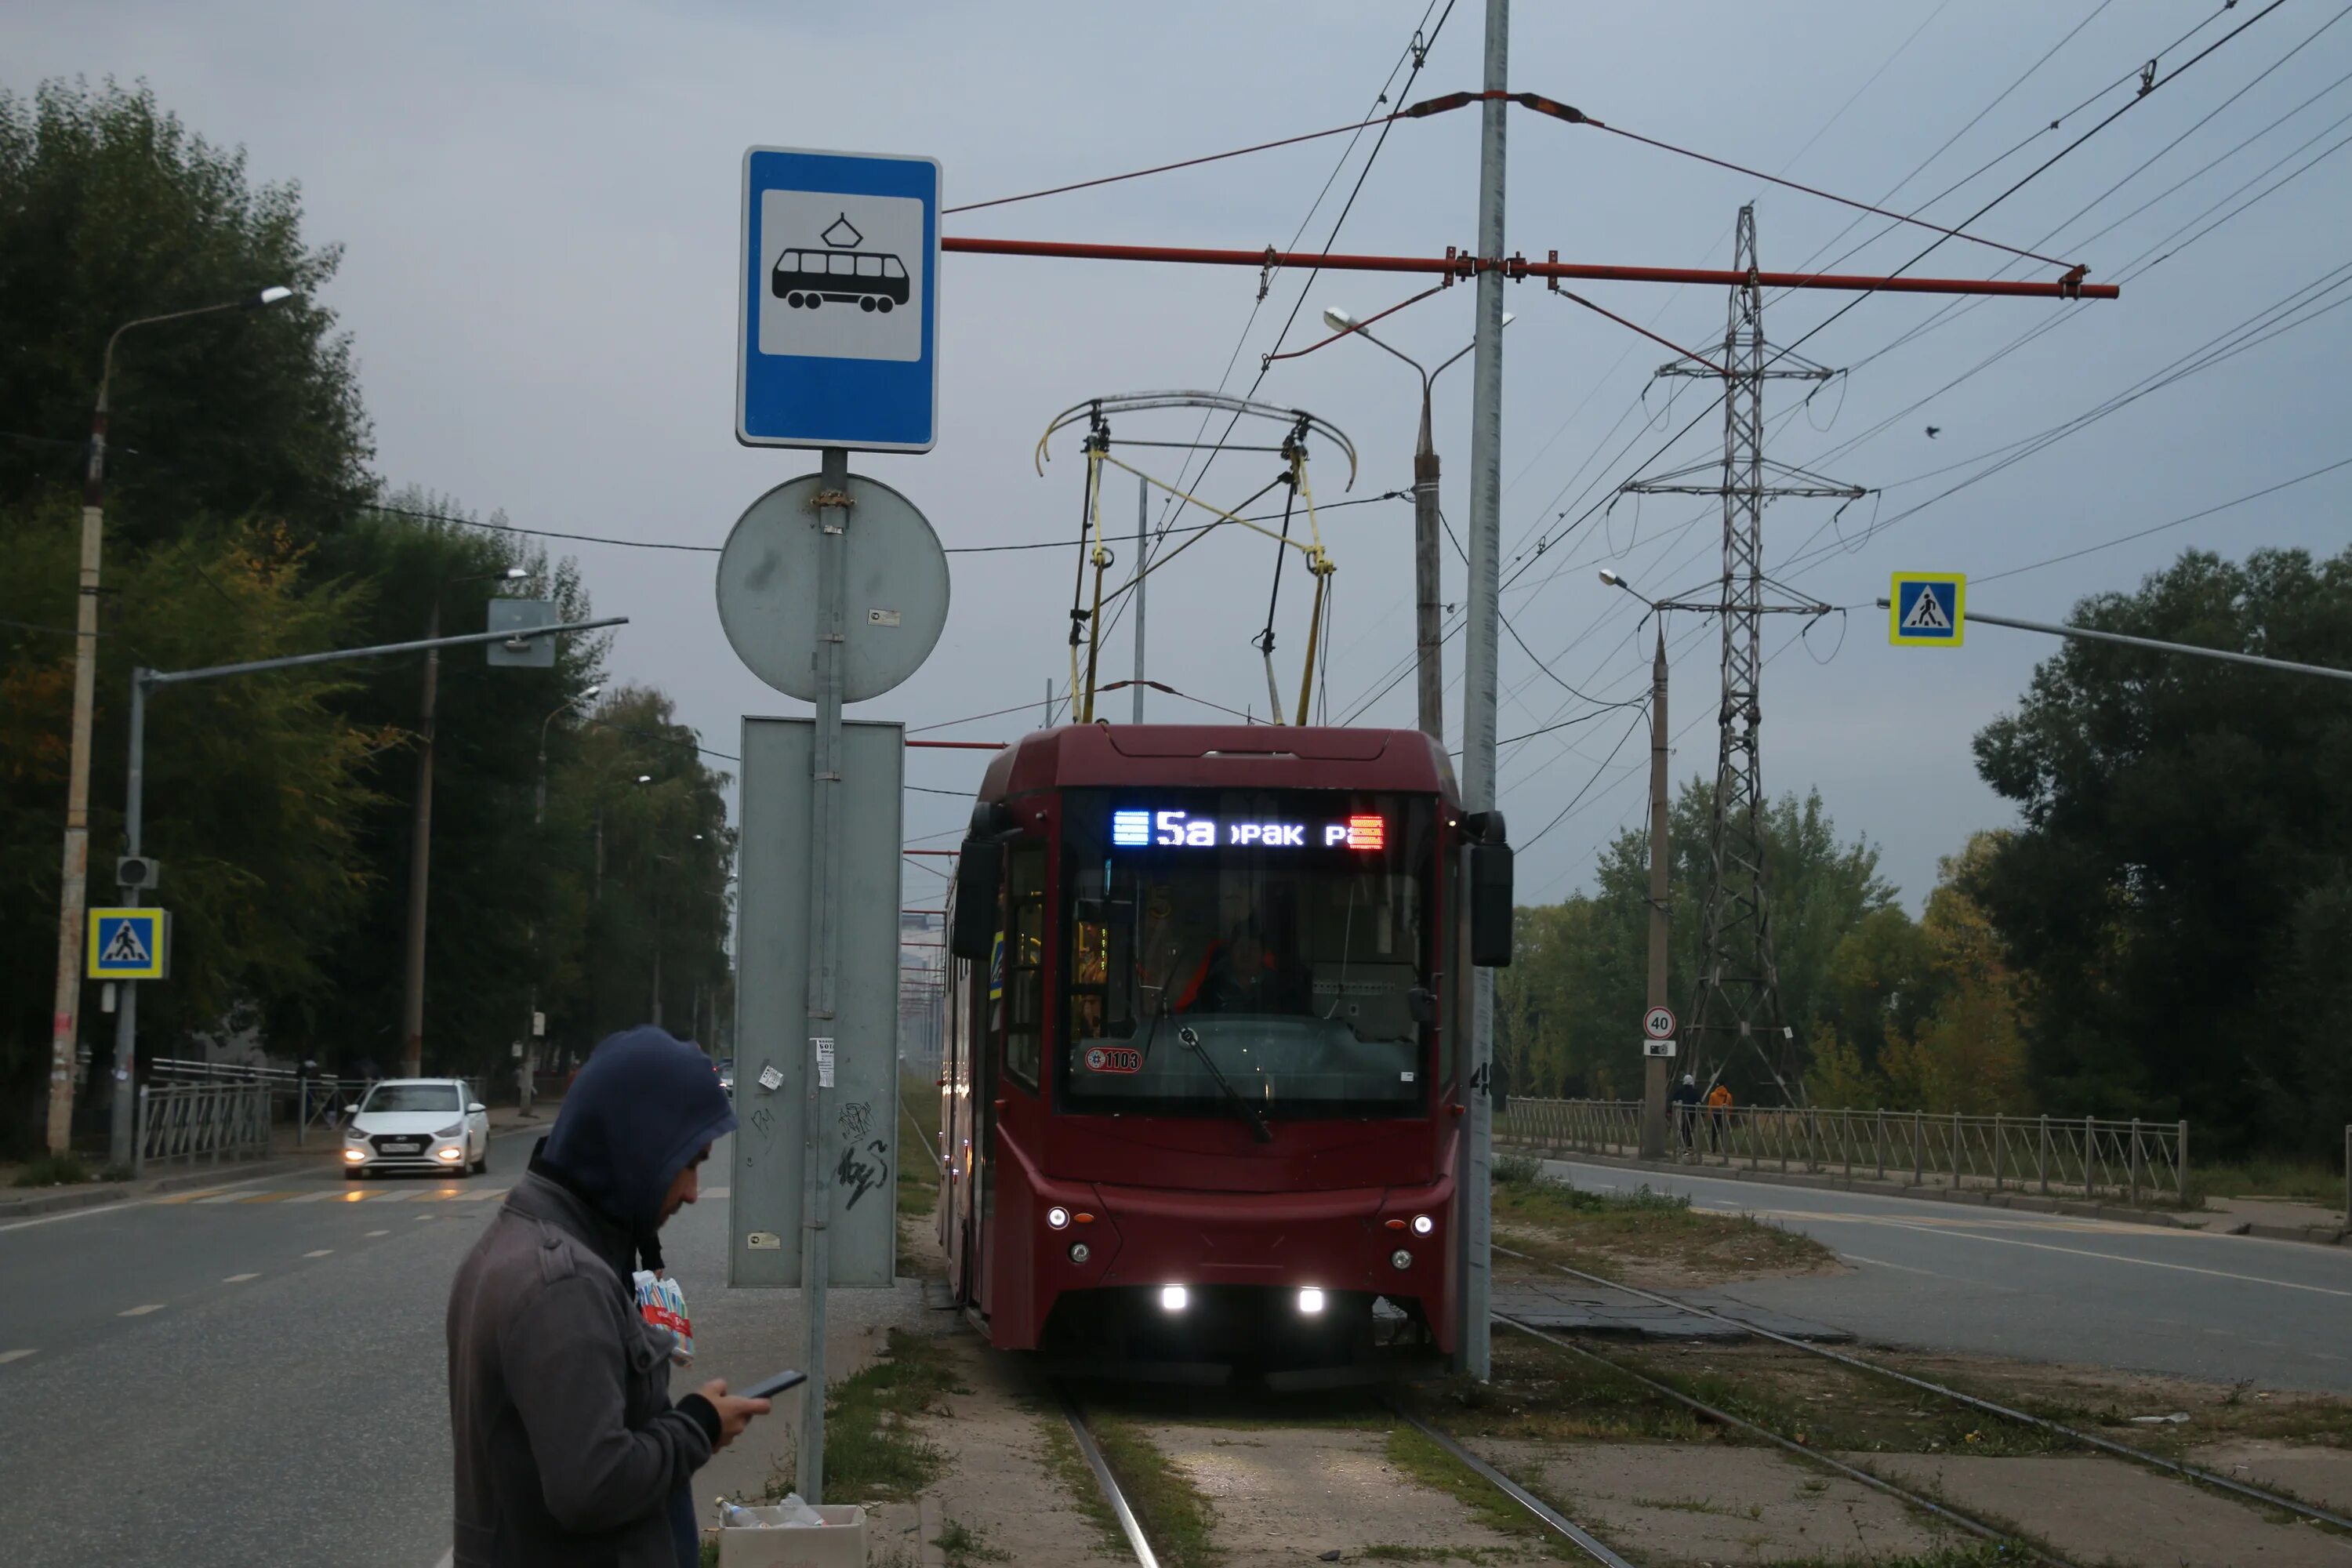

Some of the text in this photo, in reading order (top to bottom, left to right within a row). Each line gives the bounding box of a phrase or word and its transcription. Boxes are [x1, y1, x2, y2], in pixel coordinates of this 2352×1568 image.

[1156, 811, 1215, 846] 5а
[1651, 1017, 1668, 1030] 40
[1105, 1051, 1139, 1069] 1103
